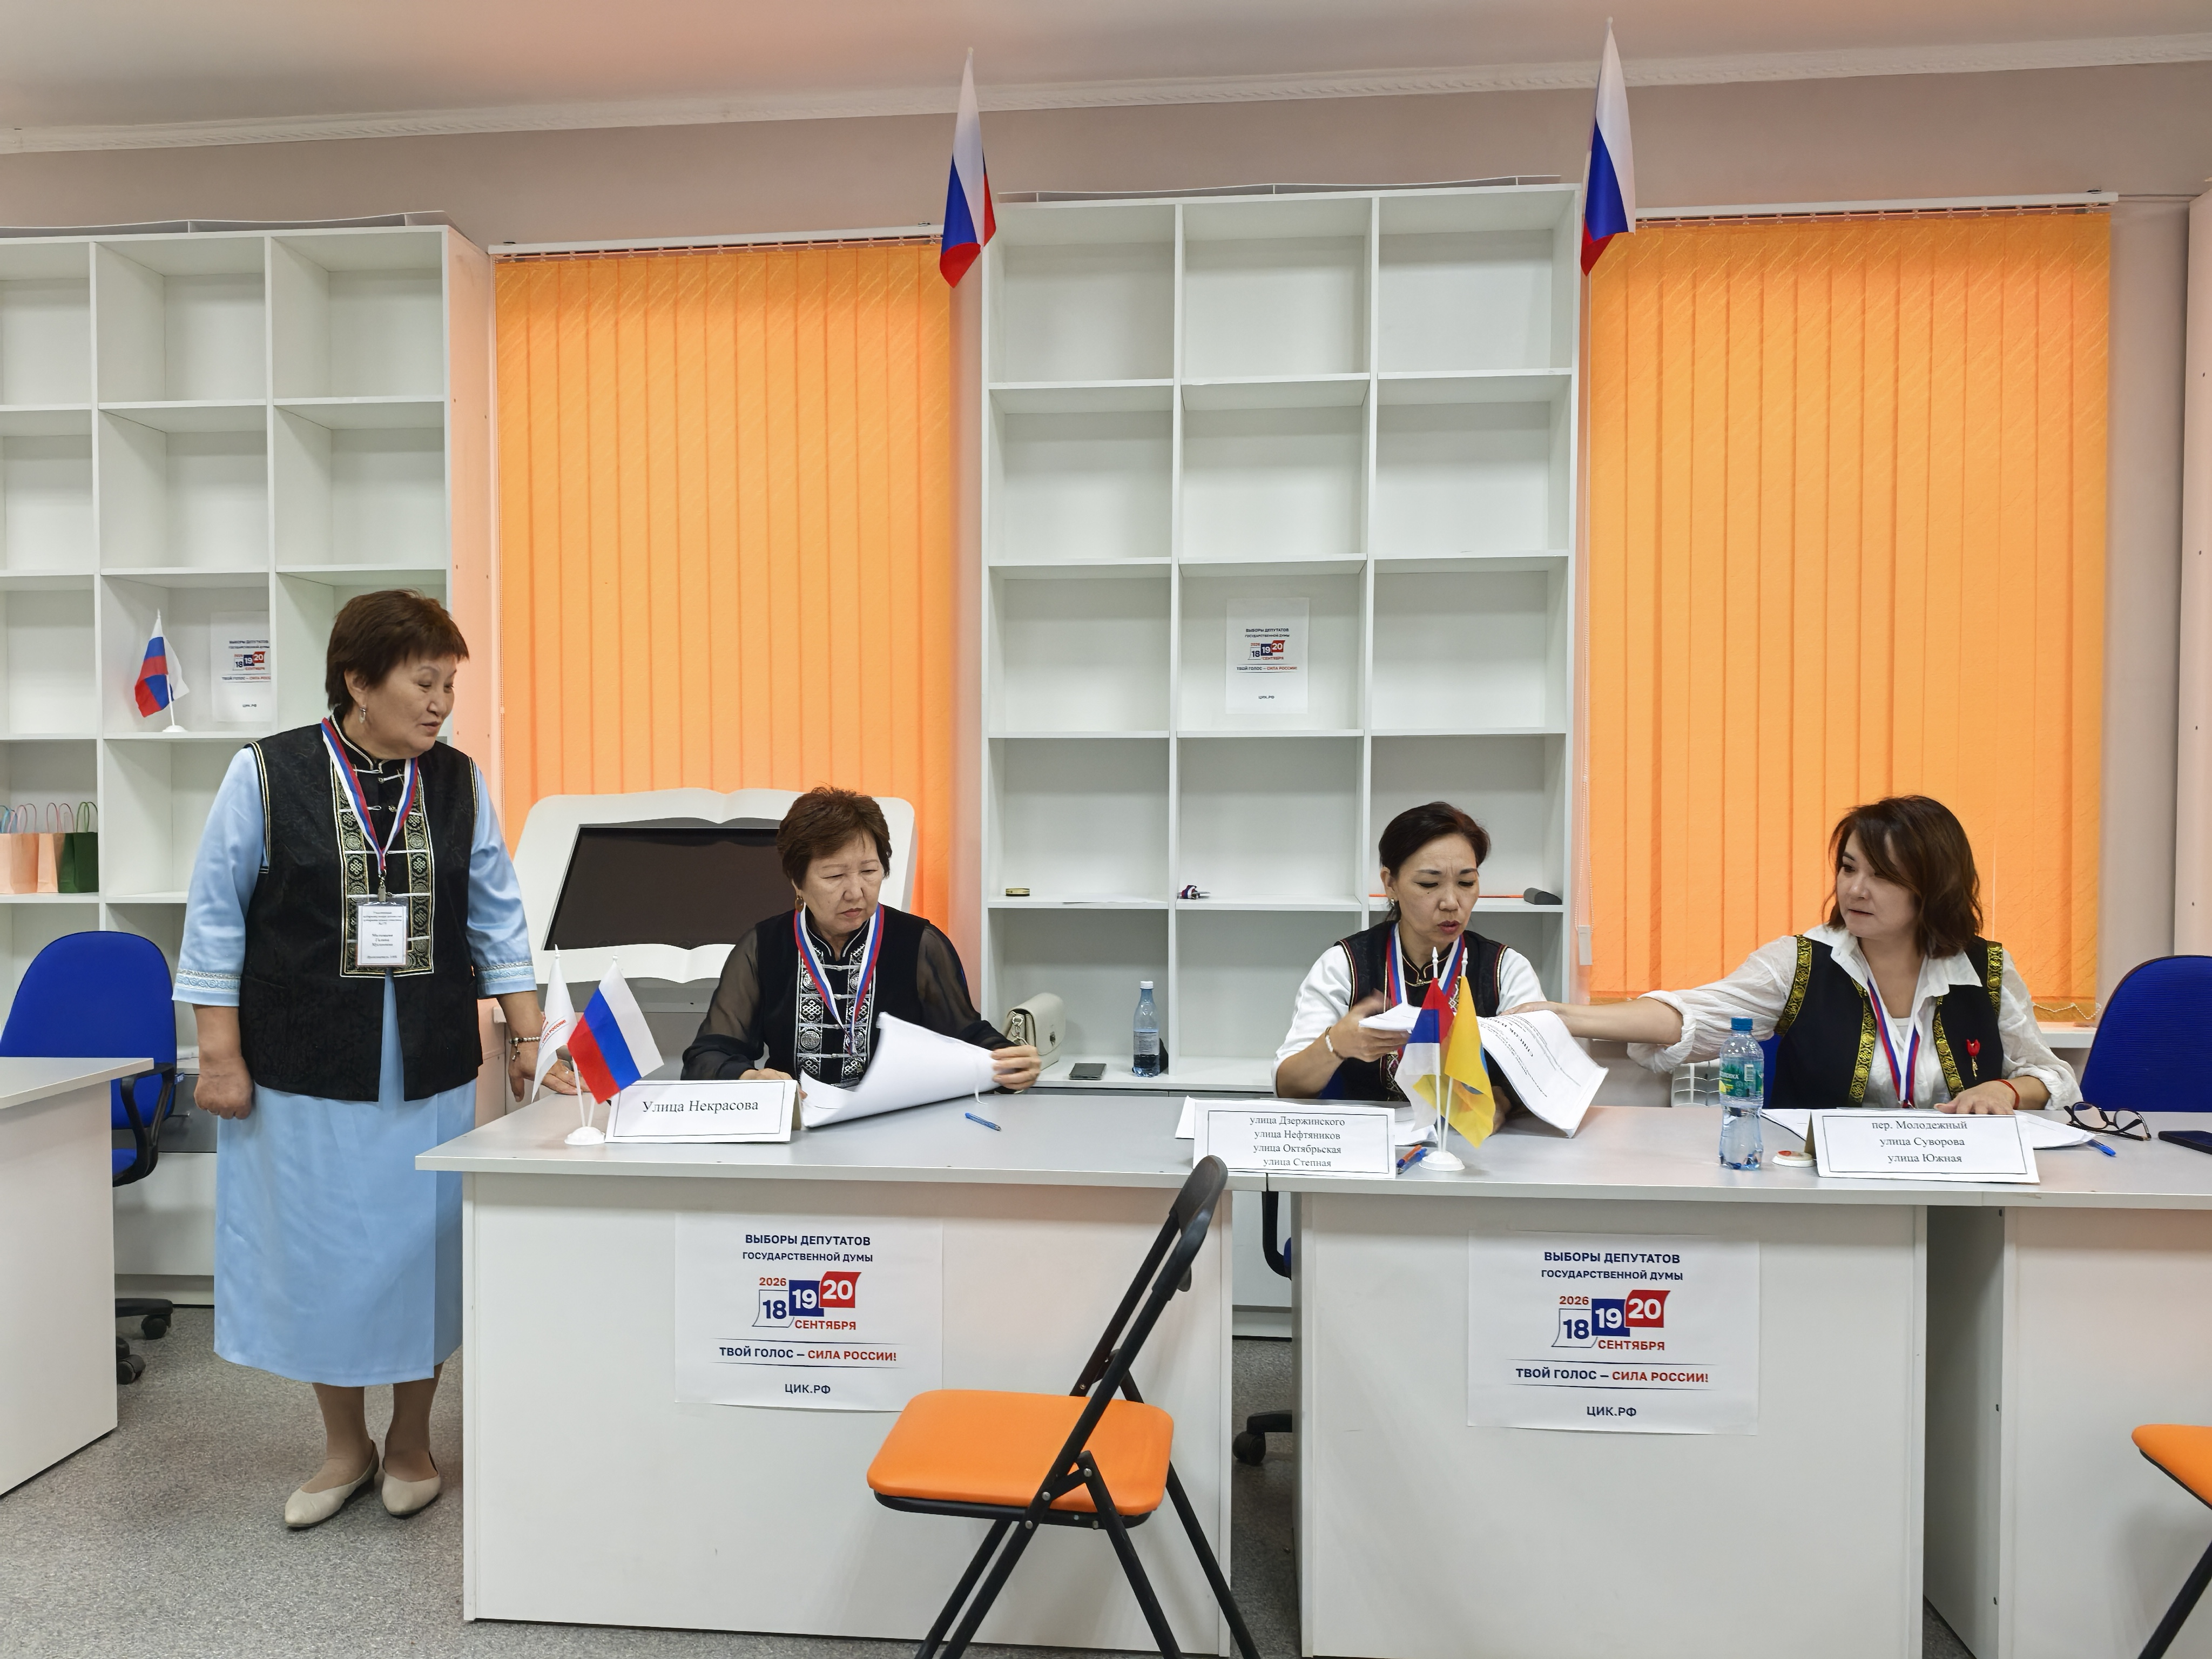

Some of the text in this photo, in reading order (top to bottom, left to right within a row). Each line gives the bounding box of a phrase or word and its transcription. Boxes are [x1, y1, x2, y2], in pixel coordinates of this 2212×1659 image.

[642, 1100, 758, 1114] Улица Некрасова
[1249, 1116, 1346, 1127] улица Дзержинского
[1871, 1120, 1968, 1131] пер. Молодежный
[1254, 1130, 1341, 1141] улица Нефтяников
[1879, 1137, 1966, 1148] улица Суворова
[1253, 1144, 1341, 1155] улица Октябрьская
[1263, 1158, 1332, 1168] улица Степная
[1887, 1154, 1963, 1164] улица Южная
[745, 1234, 871, 1246] ВЫБОРЫ ДЕПУТАТОВ
[742, 1251, 873, 1263] ГОСУДАРСТВЕННОЙ ДУМЫ
[1544, 1251, 1681, 1264] ВЫБОРЫ ДЕПУТАТОВ
[1541, 1269, 1683, 1281] ГОСУДАРСТВЕННОЙ ДУМЫ
[759, 1277, 787, 1286] 2026
[762, 1280, 853, 1319] 18 19 20
[1559, 1296, 1589, 1305] 2026
[1562, 1298, 1661, 1339] 18 19 20
[794, 1319, 857, 1330] СЕНТЯБРЯ
[1597, 1339, 1665, 1351] СЕНТЯБРЯ
[719, 1346, 751, 1357] ТВОЙ
[754, 1348, 794, 1358] ГОЛОС
[807, 1350, 841, 1360] СИЛА
[844, 1351, 896, 1361] РОССИИ!
[1515, 1367, 1550, 1379] ТВОЙ
[1554, 1369, 1597, 1380] ГОЛОС
[1611, 1371, 1648, 1381] СИЛА
[1650, 1372, 1709, 1383] РОССИИ!
[785, 1384, 831, 1394] ЦИК.РФ
[1587, 1406, 1637, 1417] ЦИК.РФ
